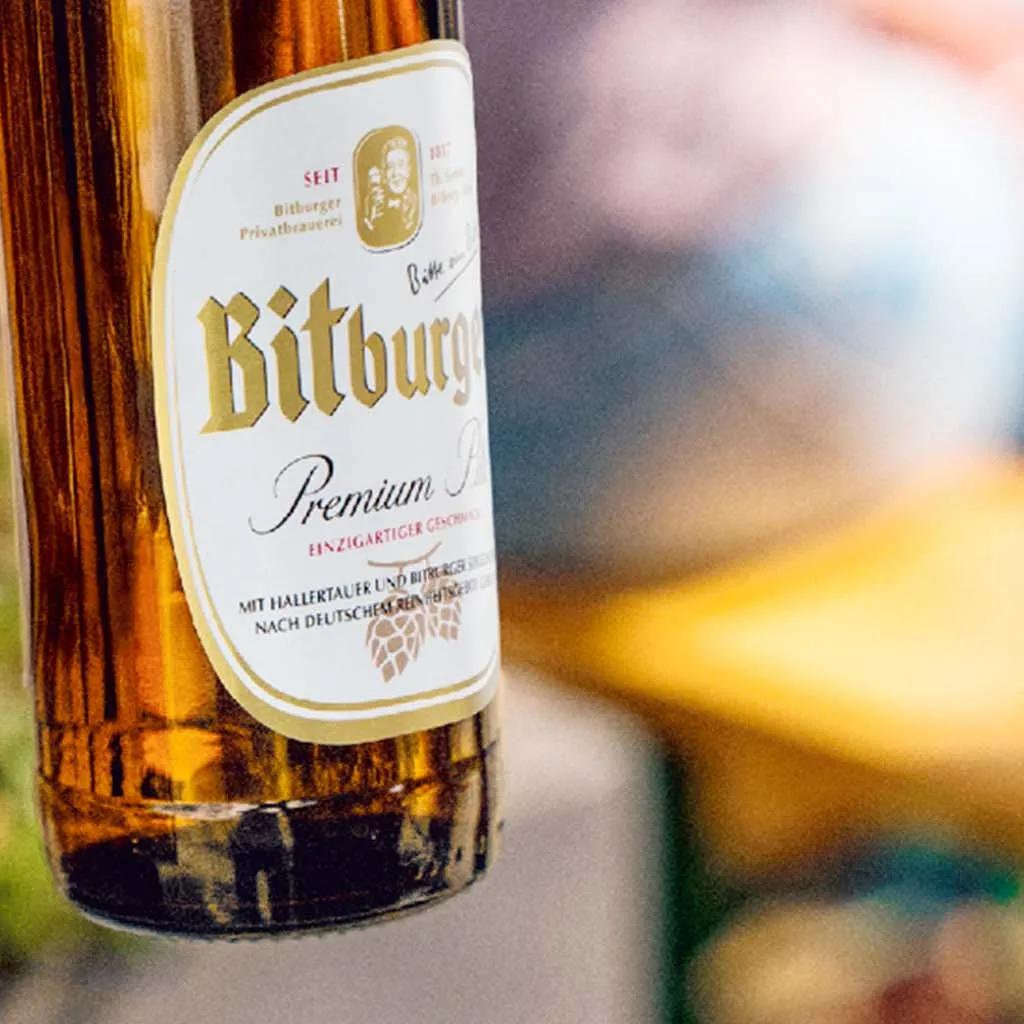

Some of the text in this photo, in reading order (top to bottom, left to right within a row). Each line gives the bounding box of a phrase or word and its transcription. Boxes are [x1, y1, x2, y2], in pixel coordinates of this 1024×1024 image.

[304, 167, 340, 187] SEIT
[274, 198, 342, 217] Bitburger
[240, 215, 343, 240] Privatbrauerei
[407, 262, 443, 295] Bitte
[248, 454, 434, 535] Premium
[309, 522, 423, 557] EINZIGARTIGER
[239, 594, 264, 614] MIT
[270, 580, 372, 610] HALLERTAUER
[375, 573, 407, 592] UND
[255, 616, 299, 635] NACH
[305, 600, 392, 629] DEUTSCHEM
